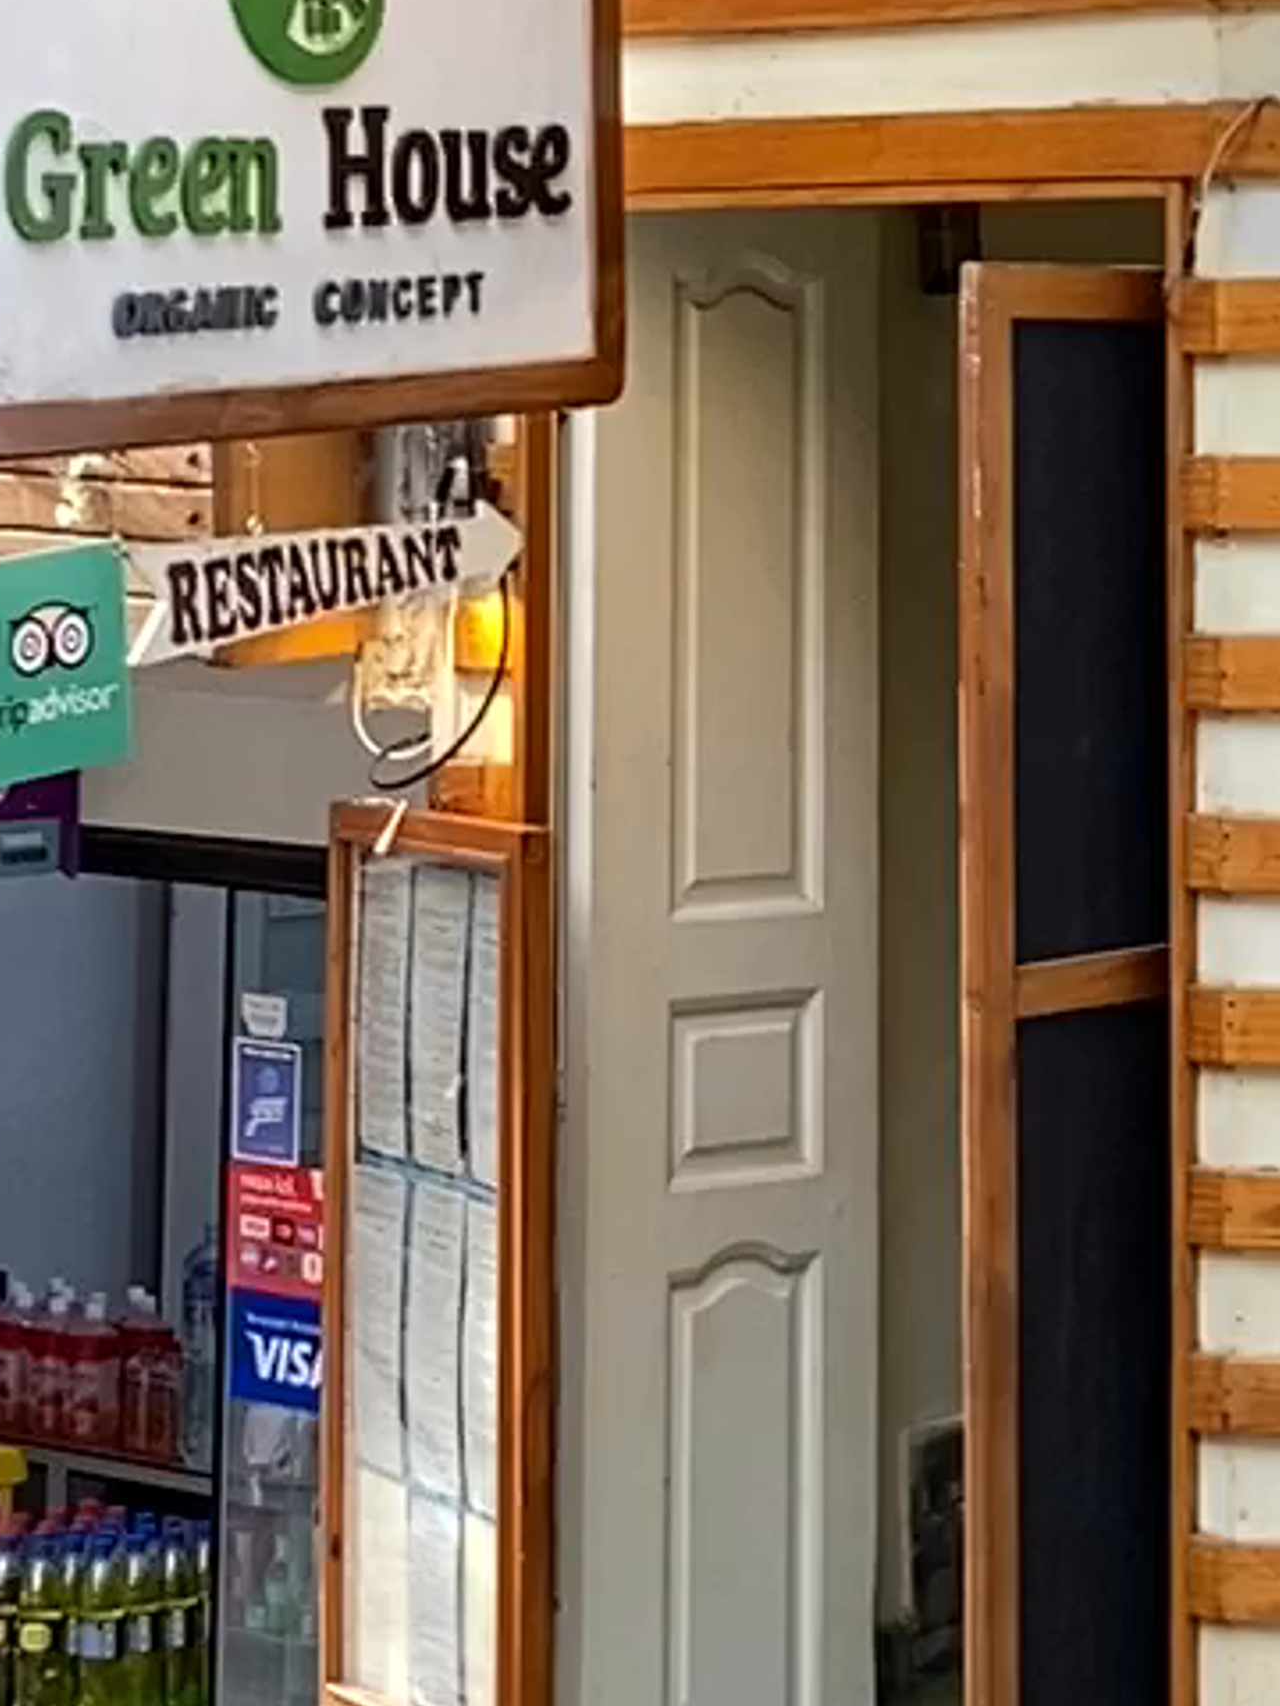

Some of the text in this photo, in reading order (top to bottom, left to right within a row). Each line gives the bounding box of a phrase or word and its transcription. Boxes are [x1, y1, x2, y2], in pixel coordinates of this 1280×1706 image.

[5, 105, 571, 244] Green House
[111, 271, 484, 339] ORGANIC CONCEPT
[167, 526, 461, 646] RESTAURANT
